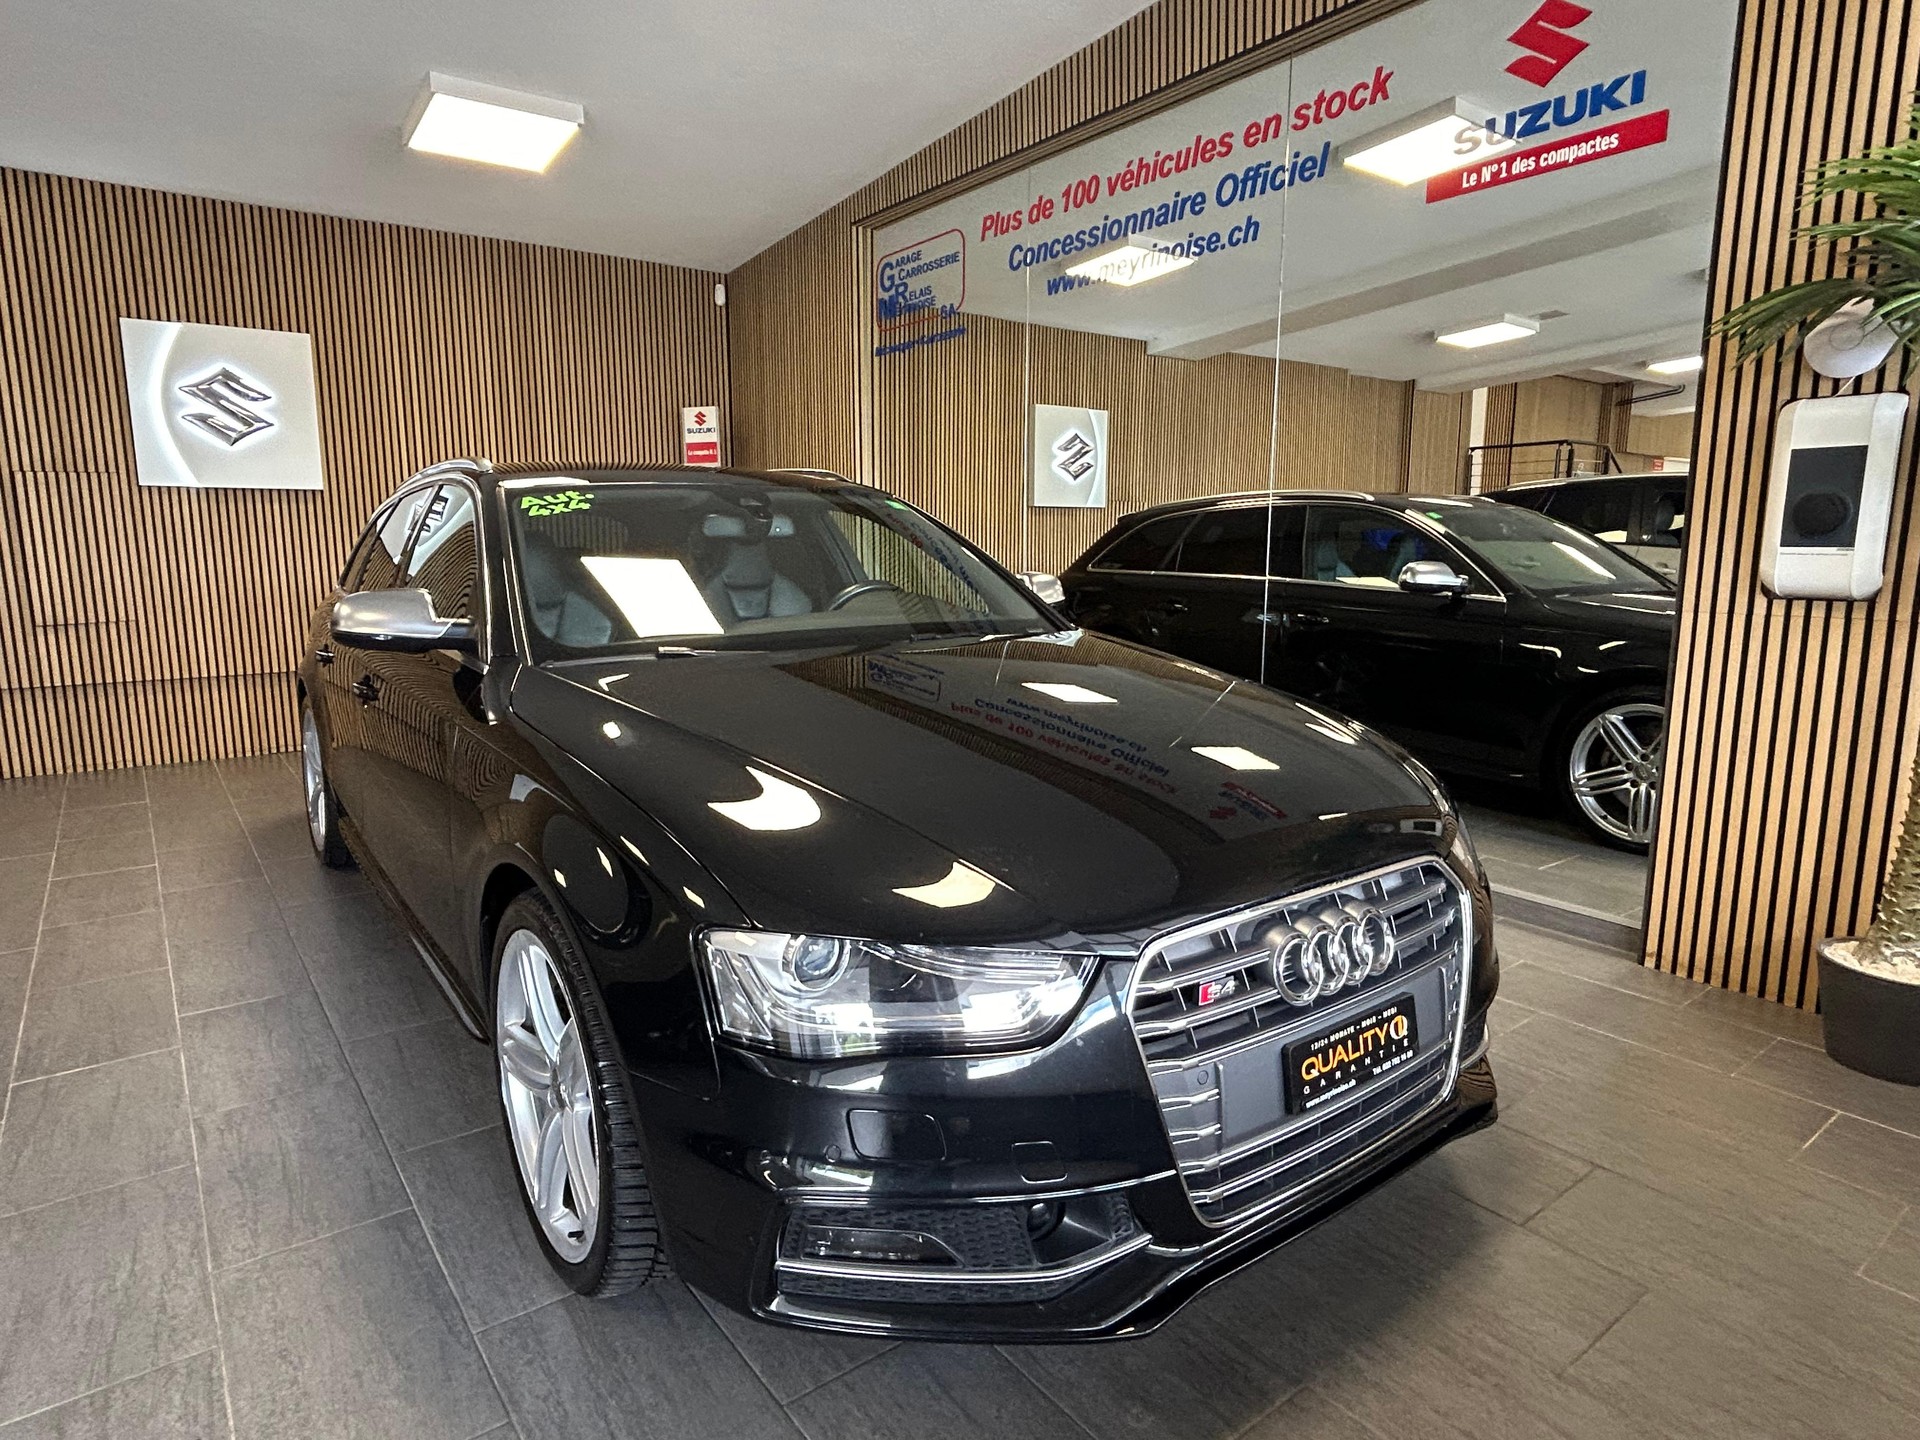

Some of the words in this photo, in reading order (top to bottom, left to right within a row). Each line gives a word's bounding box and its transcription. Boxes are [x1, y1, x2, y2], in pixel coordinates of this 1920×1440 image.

[1453, 69, 1647, 156] SUZUKI
[981, 195, 1022, 242] Plus
[1028, 195, 1054, 225] de
[1061, 174, 1099, 213] 100
[1107, 131, 1234, 197] véhicules
[1243, 113, 1282, 148] en
[1291, 65, 1394, 131] stock
[1462, 171, 1477, 189] Le
[1511, 155, 1536, 176] des
[1539, 131, 1620, 167] compactes
[1008, 191, 1206, 272] Concessionnaire
[1216, 140, 1331, 208] Officiel
[898, 251, 960, 281] CARROSSERIE
[520, 490, 594, 509] Aut.
[1301, 1022, 1389, 1081] QUALITY
